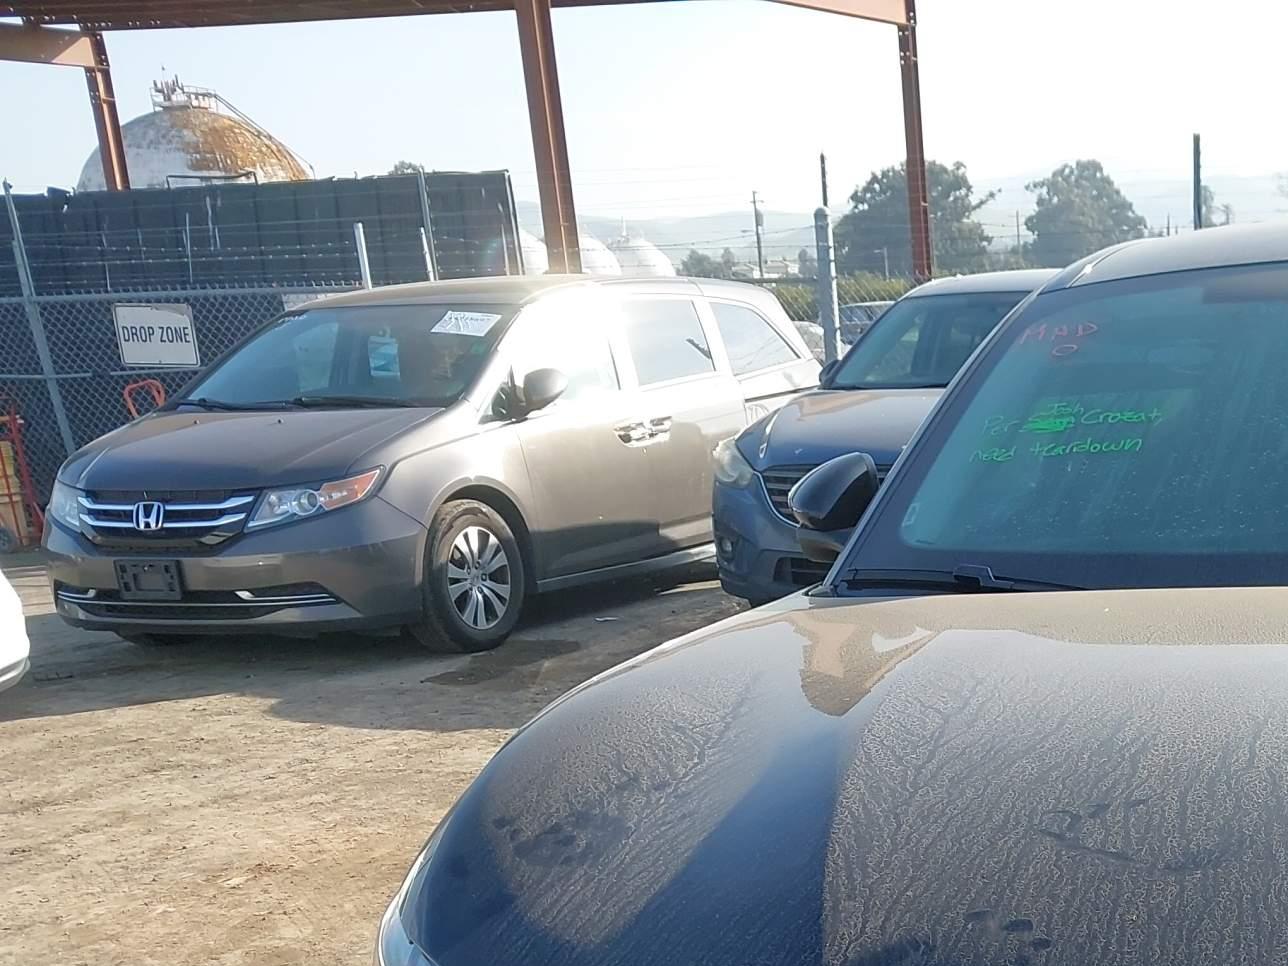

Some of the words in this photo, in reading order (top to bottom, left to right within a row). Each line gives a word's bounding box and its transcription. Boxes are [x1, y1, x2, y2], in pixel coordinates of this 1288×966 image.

[121, 326, 154, 342] DROP
[158, 326, 191, 343] ZONE
[969, 446, 1016, 463] need
[1030, 437, 1142, 456] teardown
